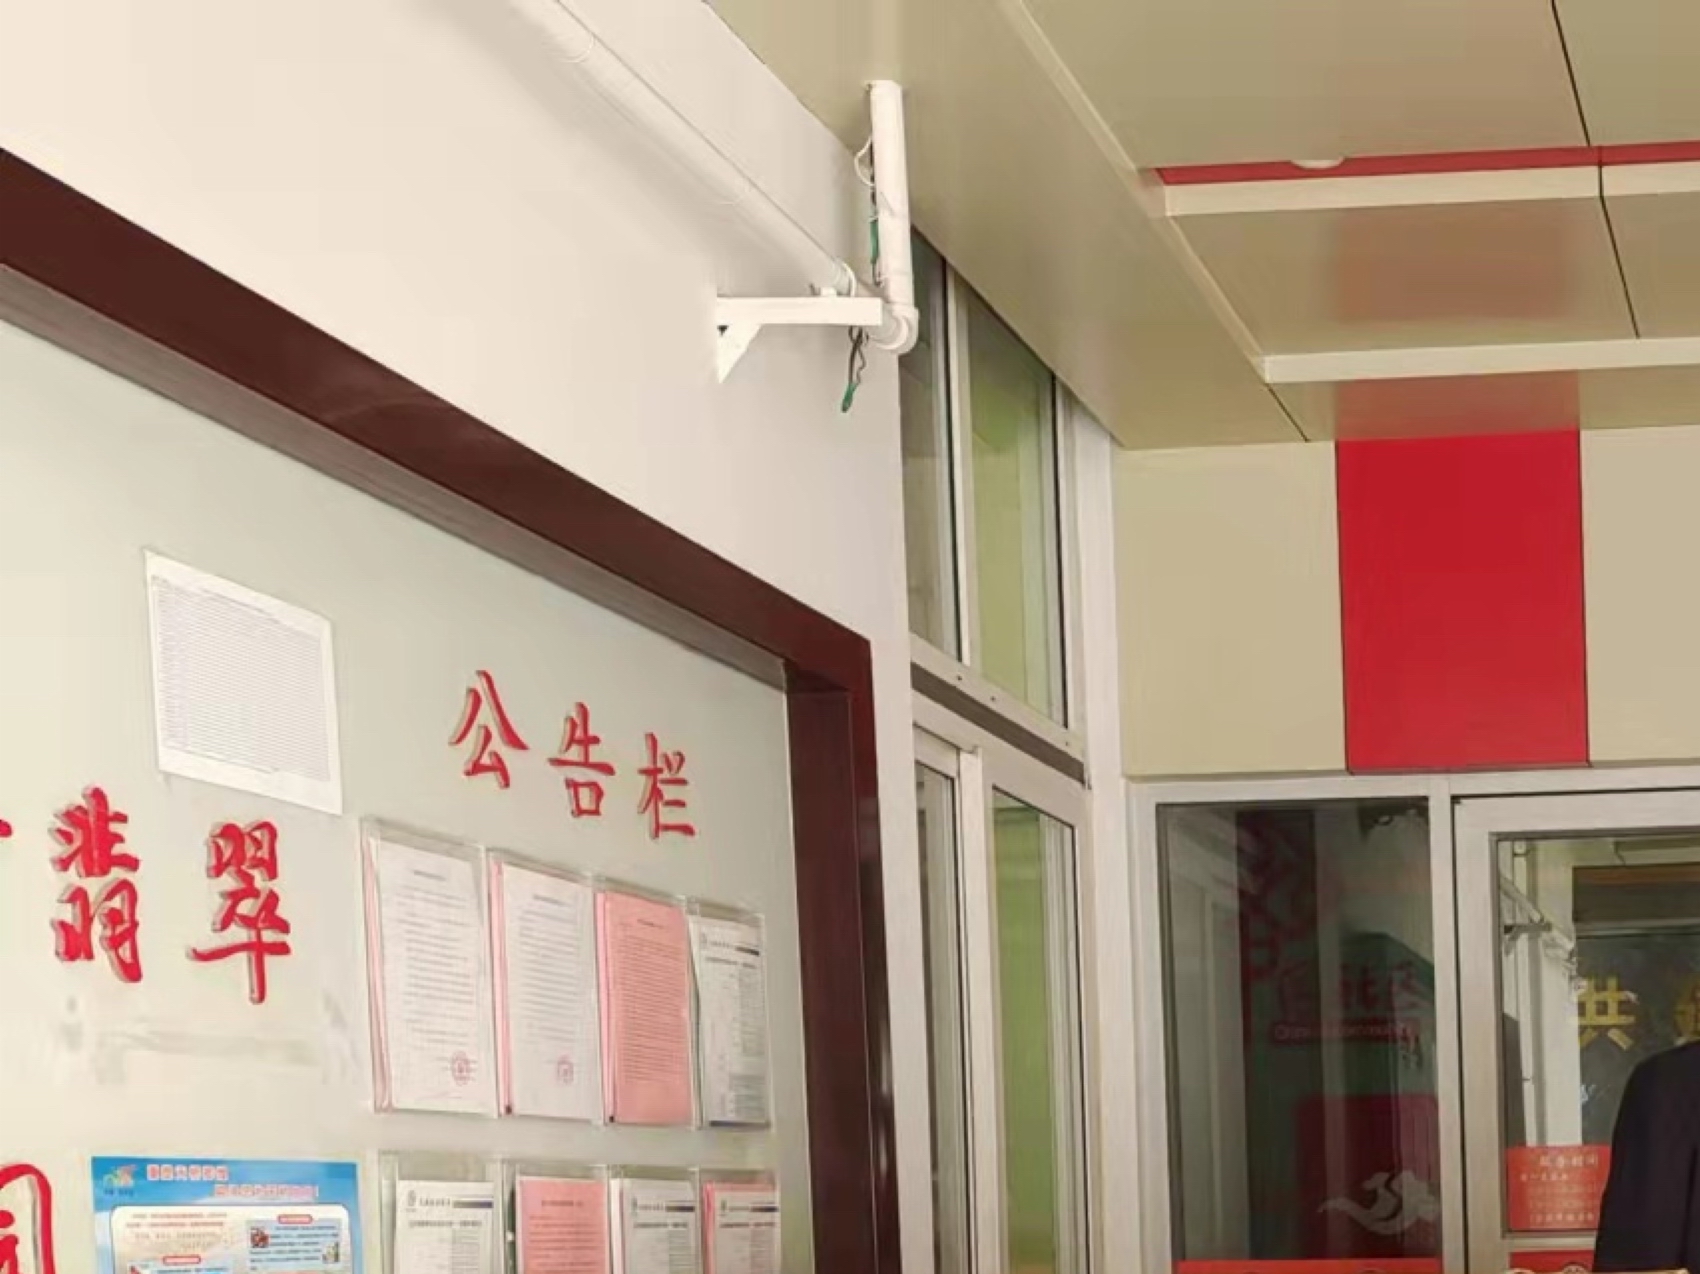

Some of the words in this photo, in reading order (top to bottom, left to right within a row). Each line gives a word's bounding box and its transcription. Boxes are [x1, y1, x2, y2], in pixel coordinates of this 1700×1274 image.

[449, 669, 697, 841] 公告栏
[0, 785, 291, 1004] 翡翠
